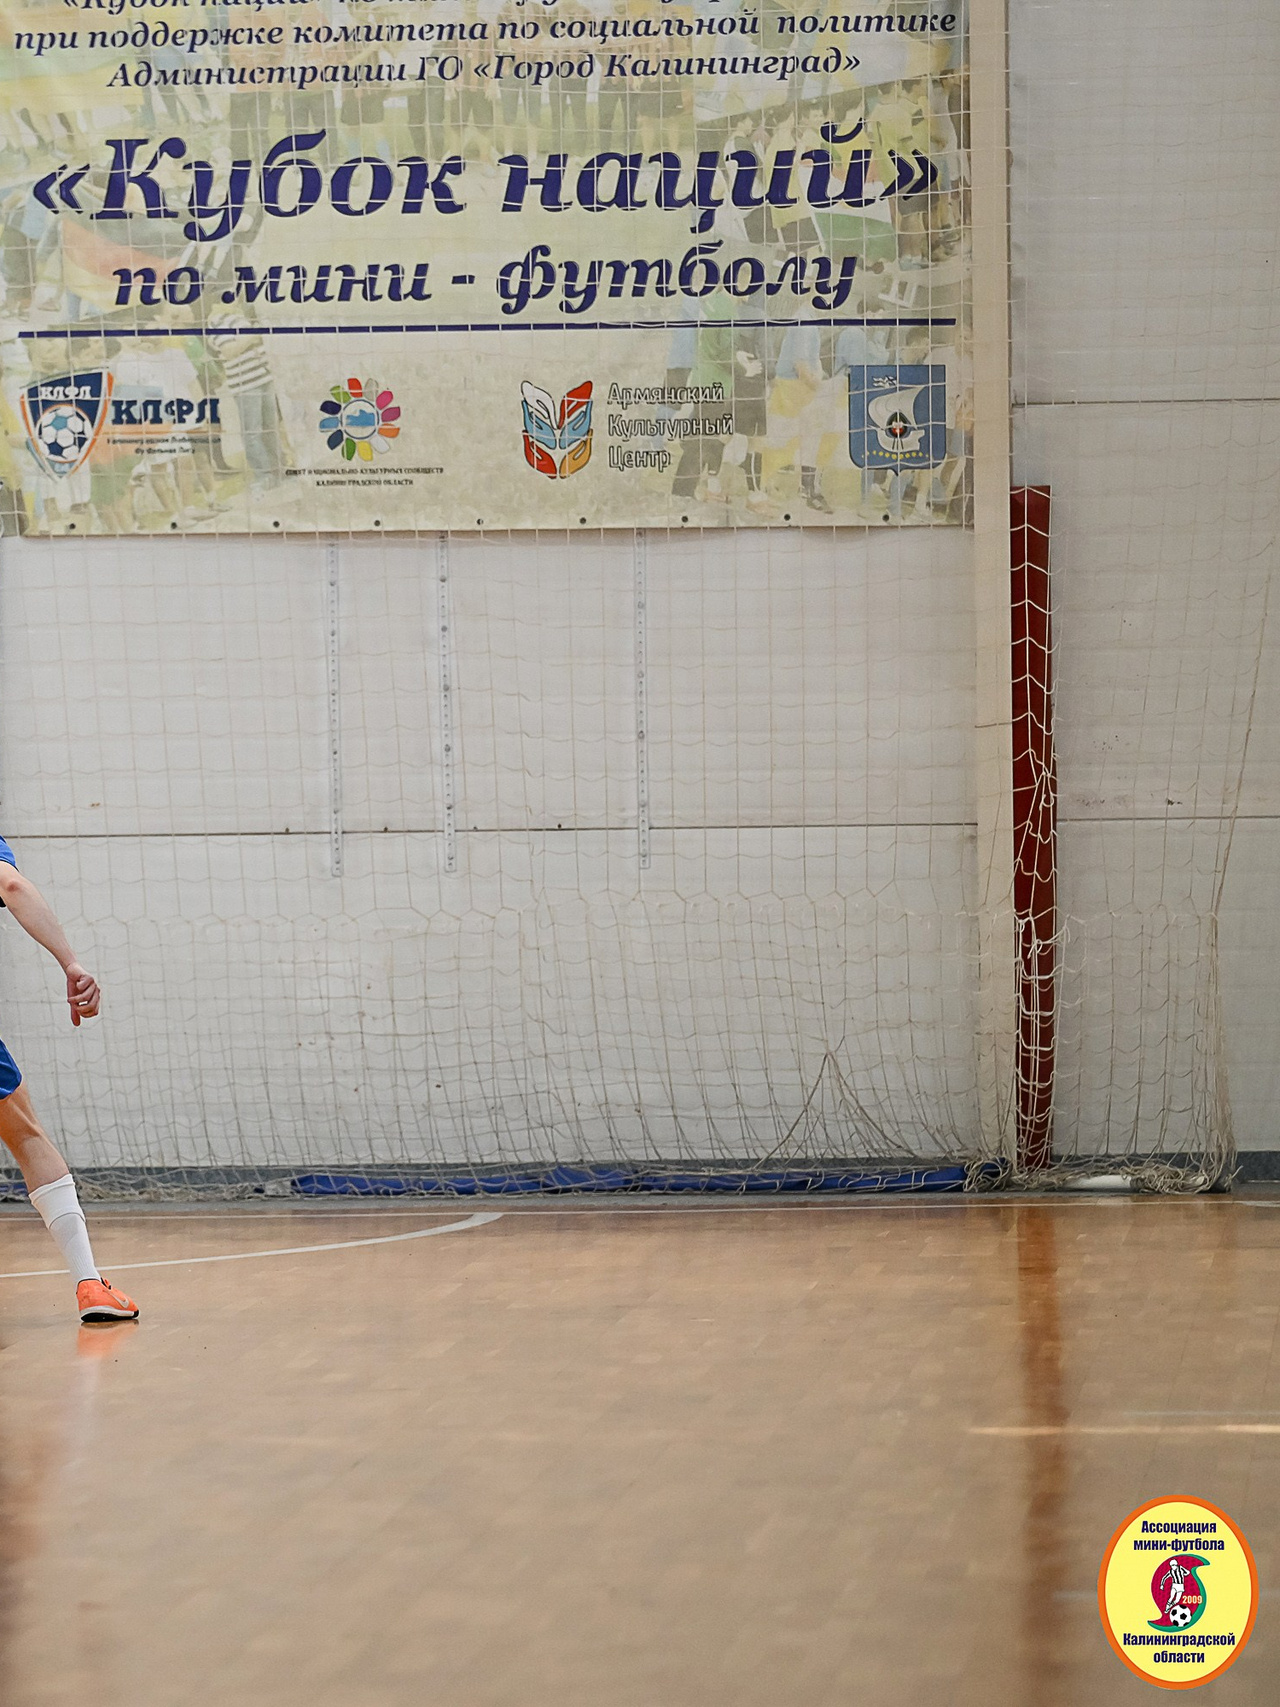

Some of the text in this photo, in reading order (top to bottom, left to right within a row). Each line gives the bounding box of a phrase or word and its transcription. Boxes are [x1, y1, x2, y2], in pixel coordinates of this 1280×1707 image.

[14, 8, 957, 56] при поддержке комитета по социальной политике
[106, 46, 862, 90] Администрации ГО «Город Калининград»
[31, 117, 939, 243] «Кубок наций»
[112, 264, 205, 306] по
[221, 263, 433, 304] мини
[496, 243, 858, 315] футболу
[111, 397, 220, 425] КЛФЛ
[607, 382, 724, 411] Армянский
[607, 413, 734, 442] Культурный
[608, 445, 671, 473] Центр
